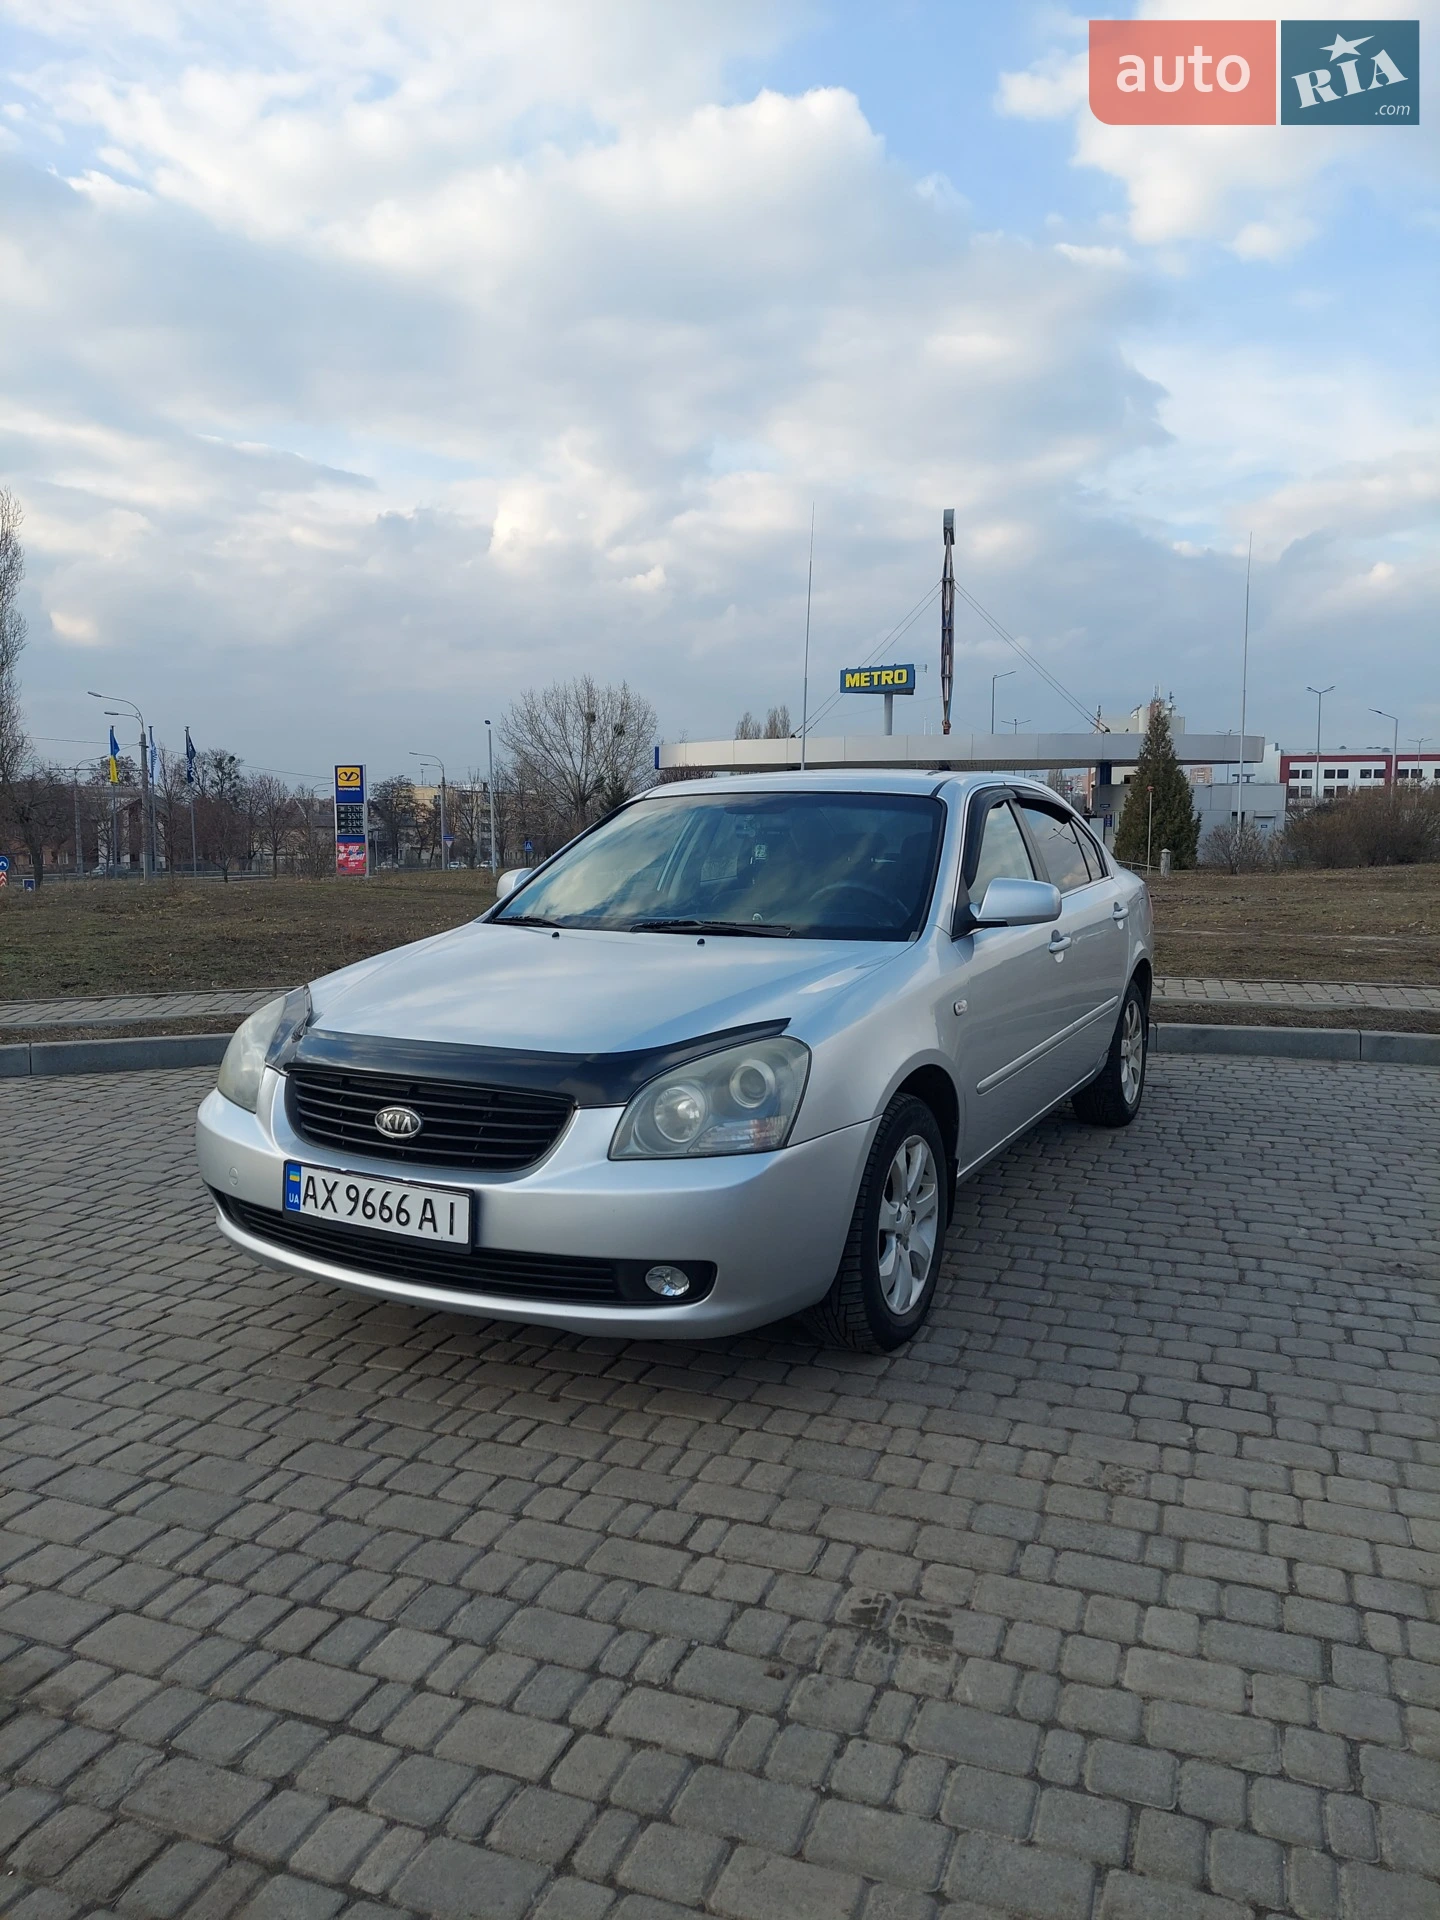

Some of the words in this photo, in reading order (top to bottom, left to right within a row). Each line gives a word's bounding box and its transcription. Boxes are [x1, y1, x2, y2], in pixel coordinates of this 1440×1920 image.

[845, 669, 907, 688] METRO
[382, 1112, 412, 1132] KIA
[288, 1192, 299, 1204] UA
[302, 1175, 339, 1213] AX
[345, 1184, 411, 1227] 9666
[418, 1197, 455, 1236] AI
